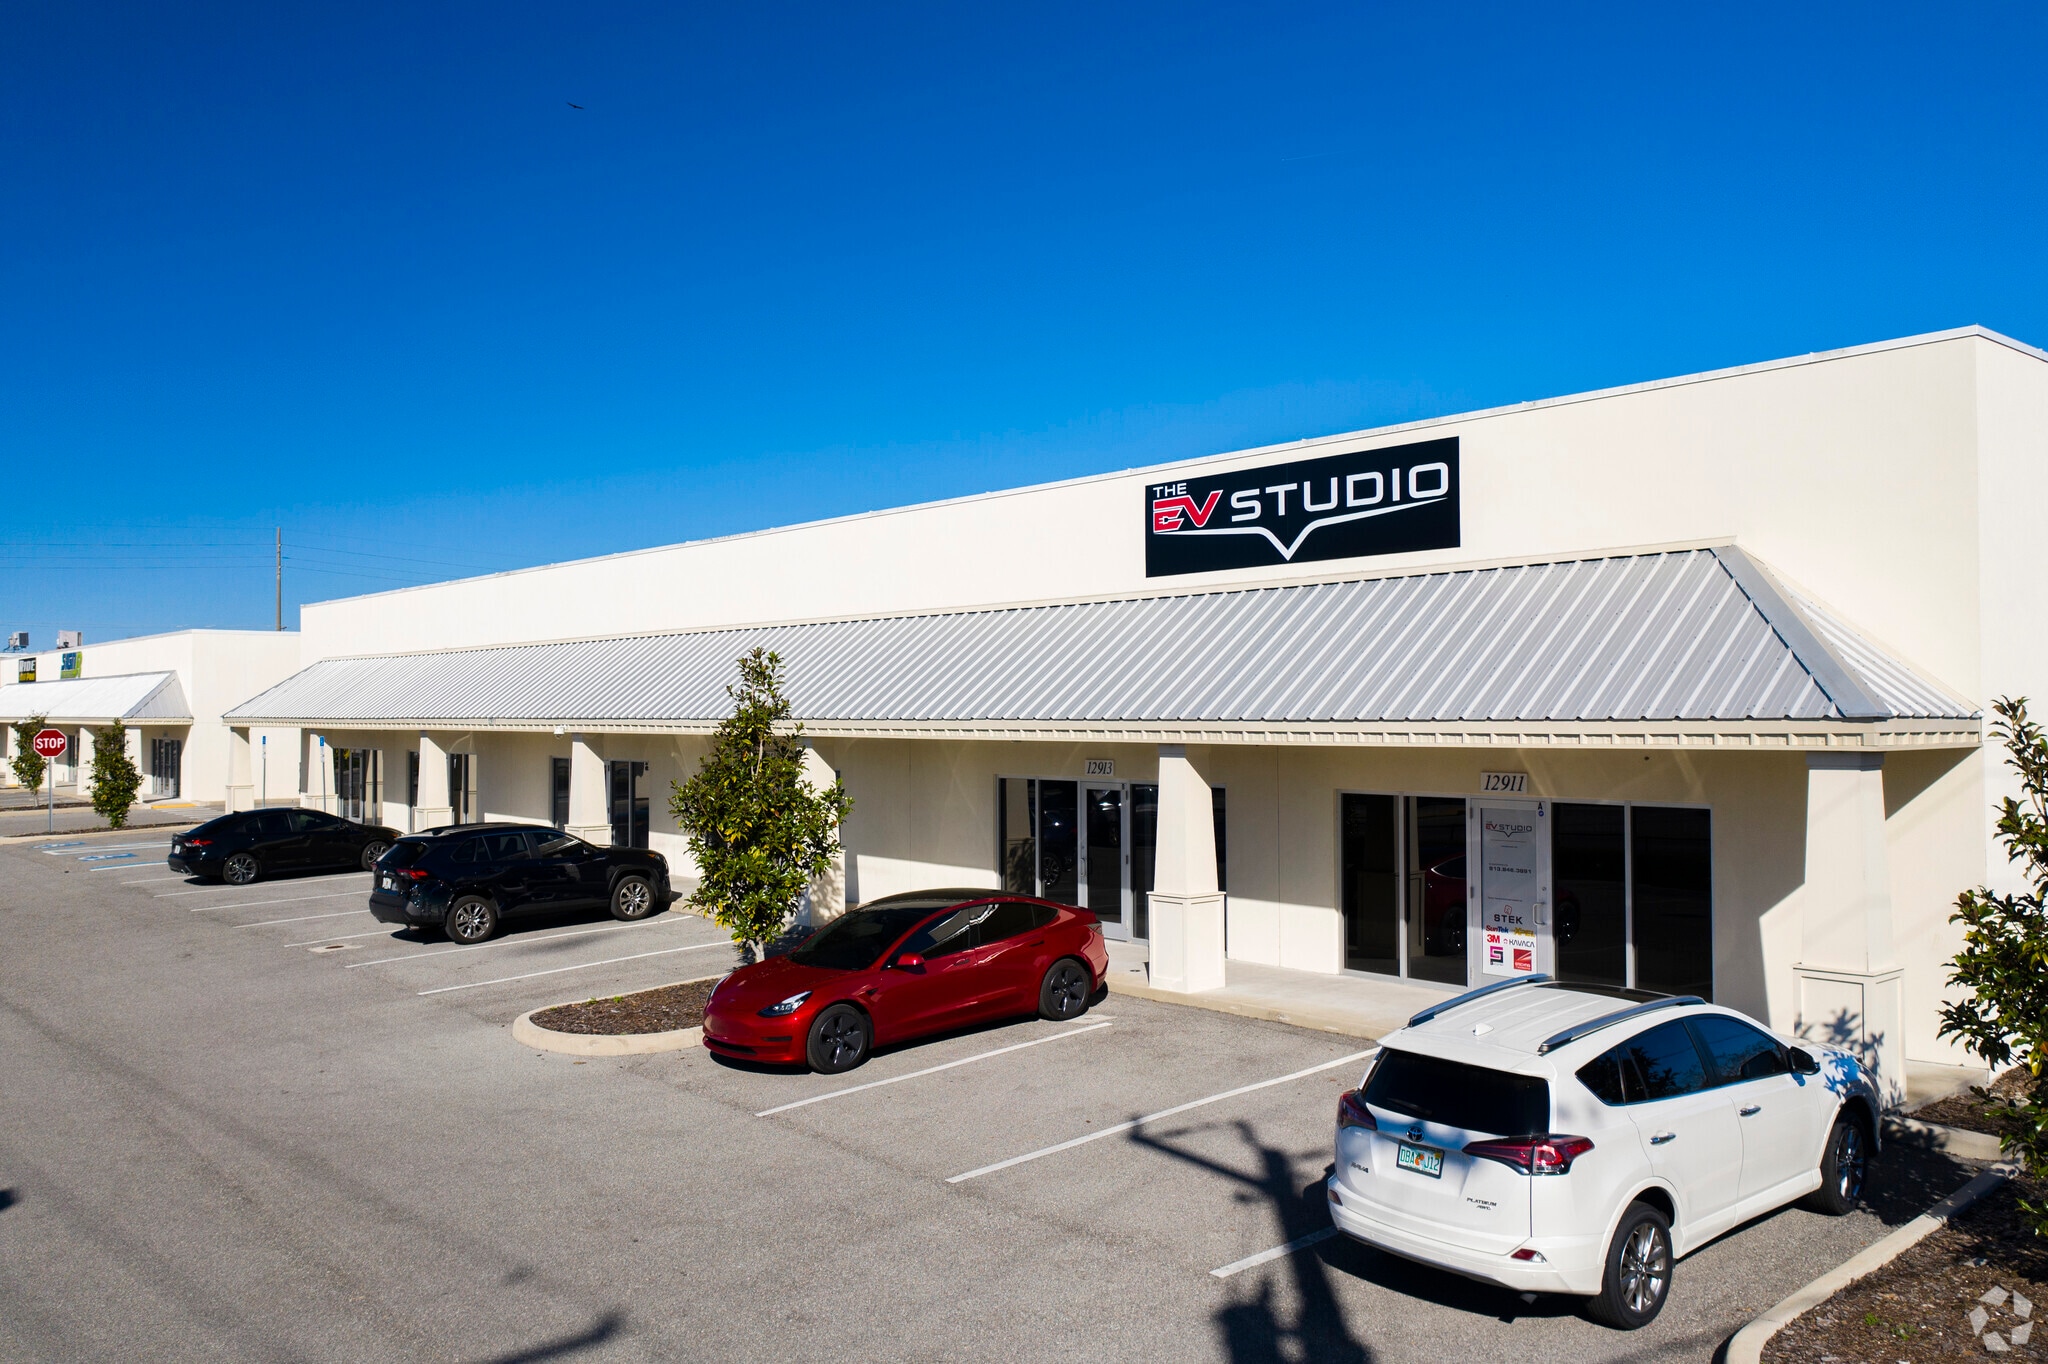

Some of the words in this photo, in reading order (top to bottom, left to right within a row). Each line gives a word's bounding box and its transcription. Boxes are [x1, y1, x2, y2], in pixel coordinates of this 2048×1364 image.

[1153, 483, 1187, 498] THE
[1153, 489, 1223, 533] EV
[1231, 462, 1449, 523] STUDIO
[36, 737, 65, 749] STOP
[1087, 761, 1113, 775] 12913
[1484, 774, 1525, 792] 12911
[1499, 824, 1533, 832] STUDIO
[1493, 914, 1523, 925] STEK
[1486, 924, 1509, 933] SunTek
[1486, 934, 1500, 944] 3M
